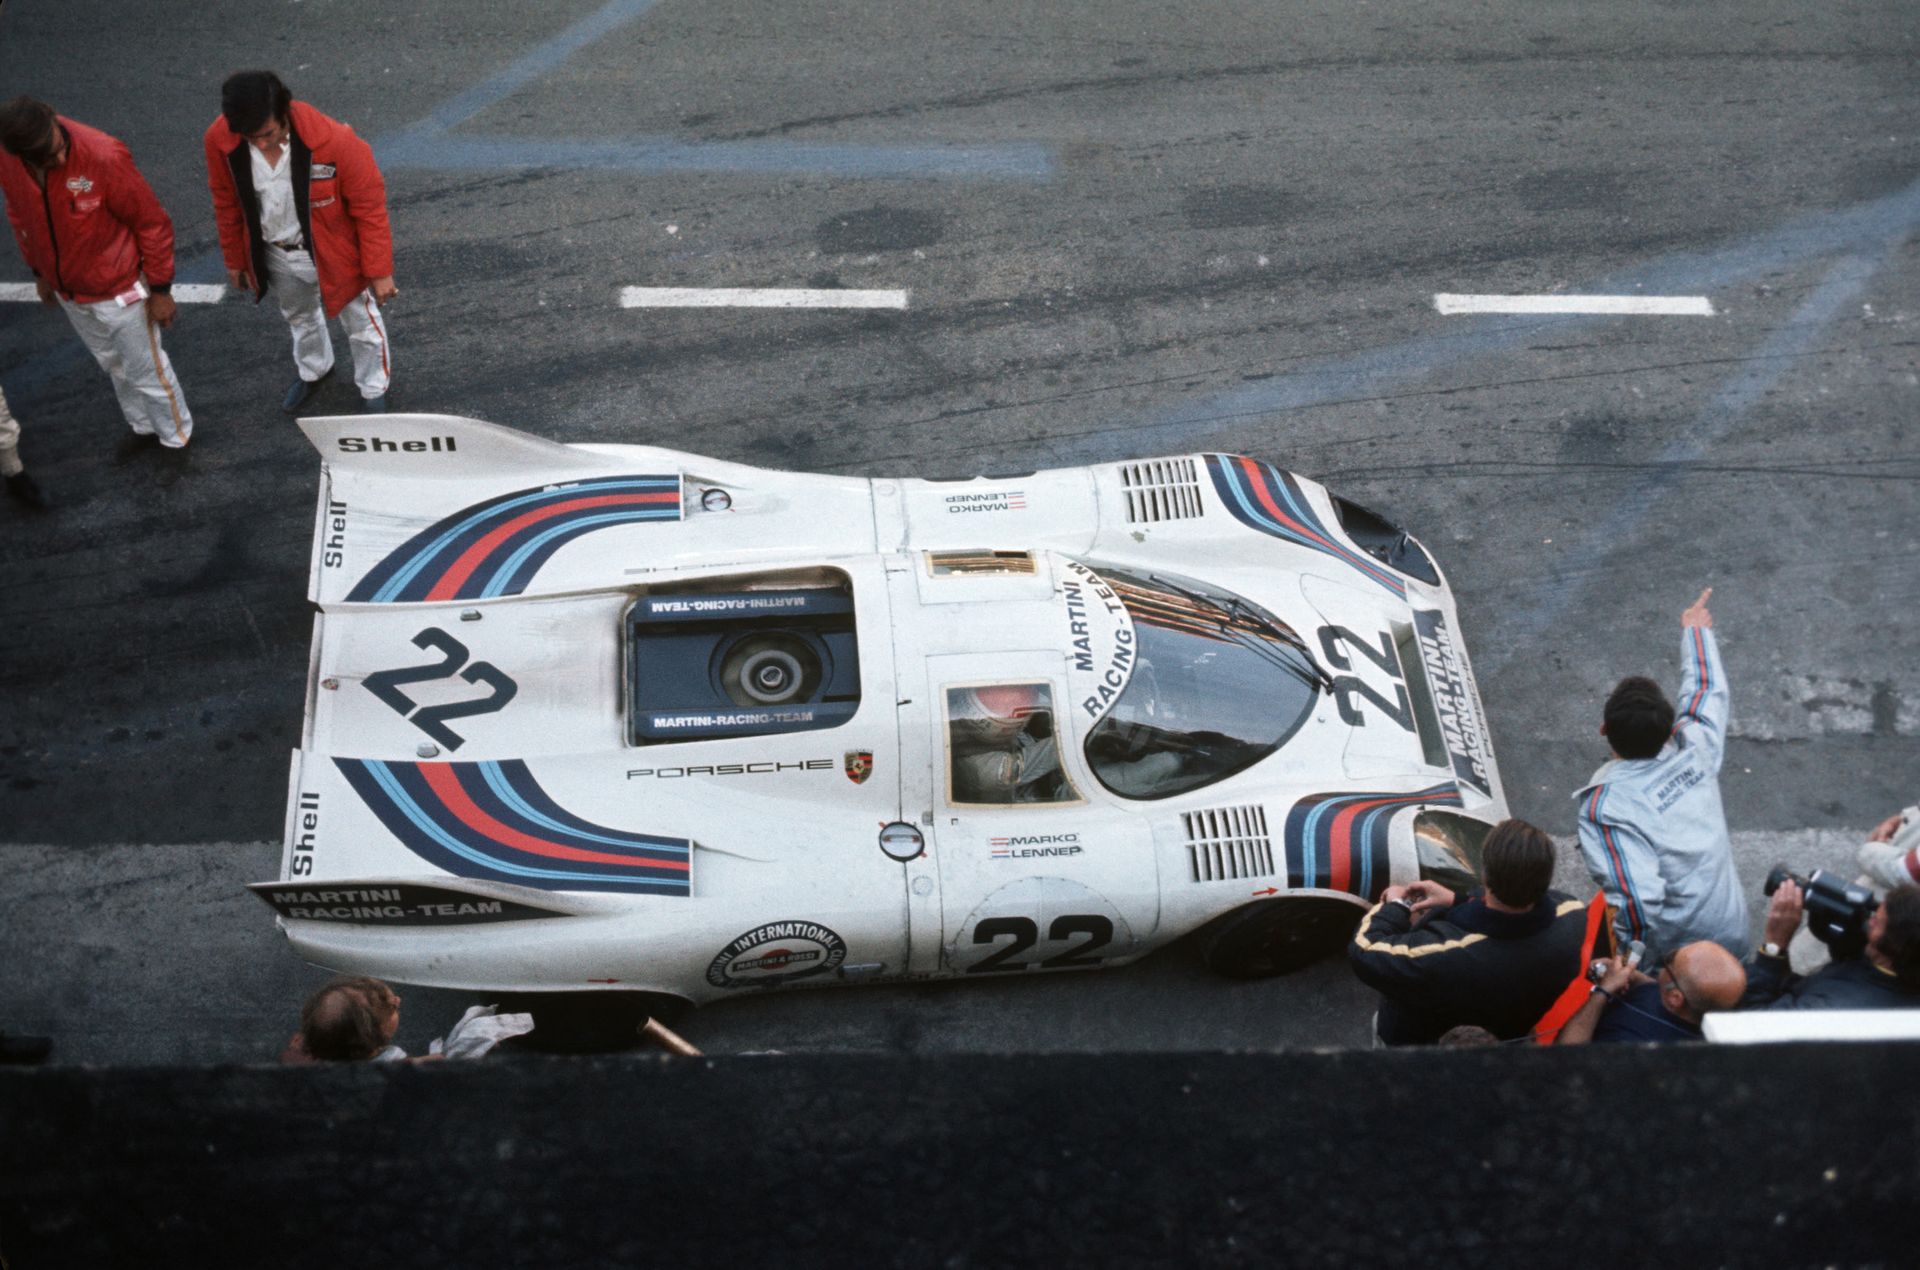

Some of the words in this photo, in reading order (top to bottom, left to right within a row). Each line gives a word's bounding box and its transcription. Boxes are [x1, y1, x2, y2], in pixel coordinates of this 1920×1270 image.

[338, 436, 457, 453] Shell
[946, 493, 1007, 503] LENNEP
[949, 502, 1009, 513] MARKO
[324, 501, 348, 569] Shell
[651, 596, 806, 612] MARTINI-RACING-TEAM
[1063, 582, 1094, 671] MARTINI
[361, 626, 518, 753] 22
[1317, 624, 1417, 734] 22
[1420, 635, 1468, 757] MARTINI
[654, 711, 814, 728] MARTINI-RACING-TEAM
[627, 759, 834, 780] PORSCHE
[1656, 766, 1696, 800] MARTINI
[292, 792, 320, 876] Shell
[1011, 834, 1079, 846] MARKO
[1012, 845, 1084, 858] LENNEP
[272, 888, 402, 905] MARTINI
[734, 923, 839, 952] INTERNATIONAL
[965, 914, 1114, 974] 22
[736, 957, 778, 971] MARTINI
